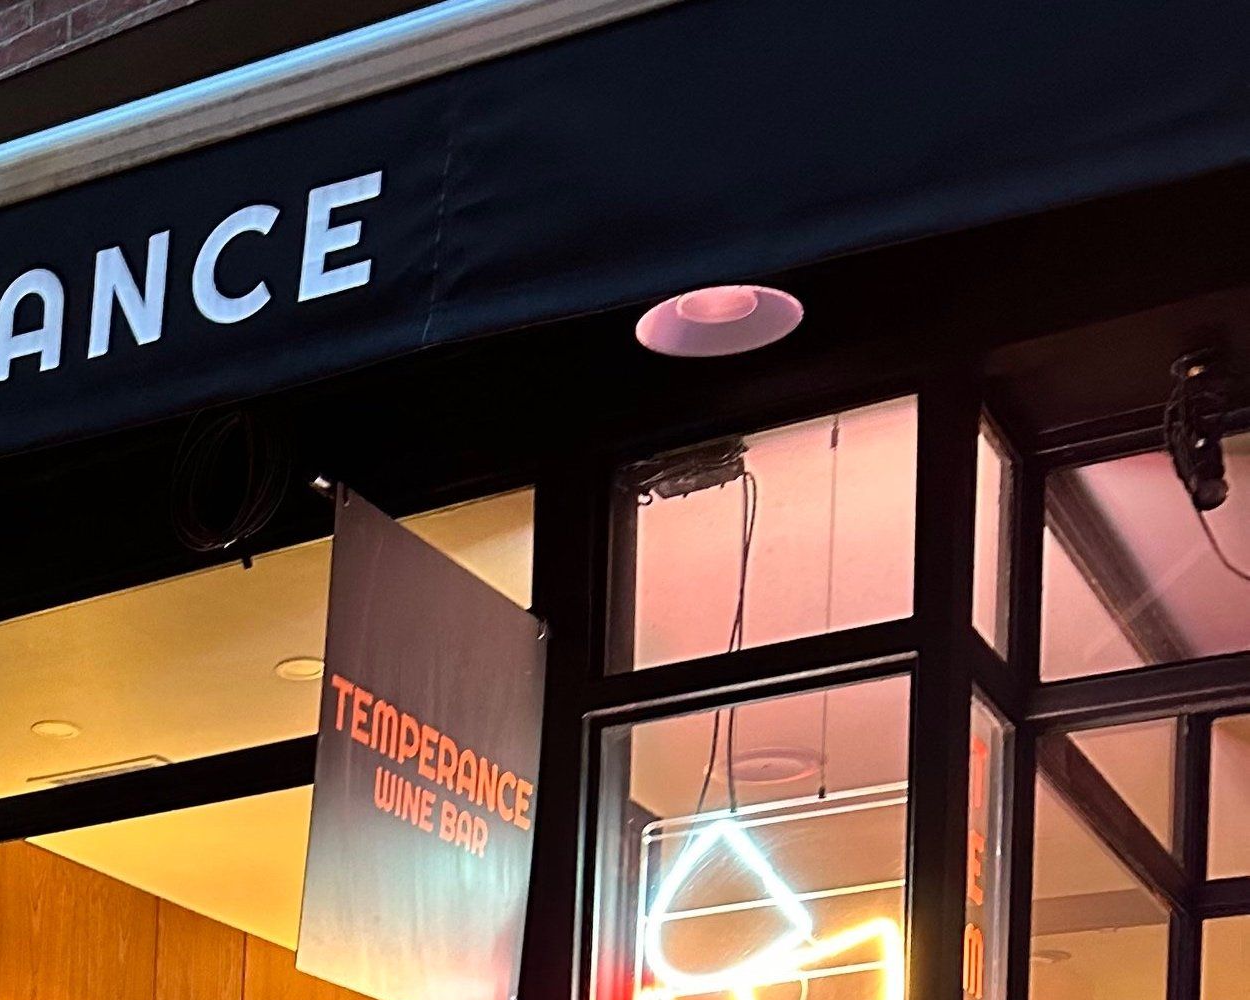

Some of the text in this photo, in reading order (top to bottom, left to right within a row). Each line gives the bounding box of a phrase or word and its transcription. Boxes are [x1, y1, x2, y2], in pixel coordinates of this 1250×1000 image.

[330, 673, 534, 831] TEMPERANCE
[374, 766, 490, 859] WINE BAR
